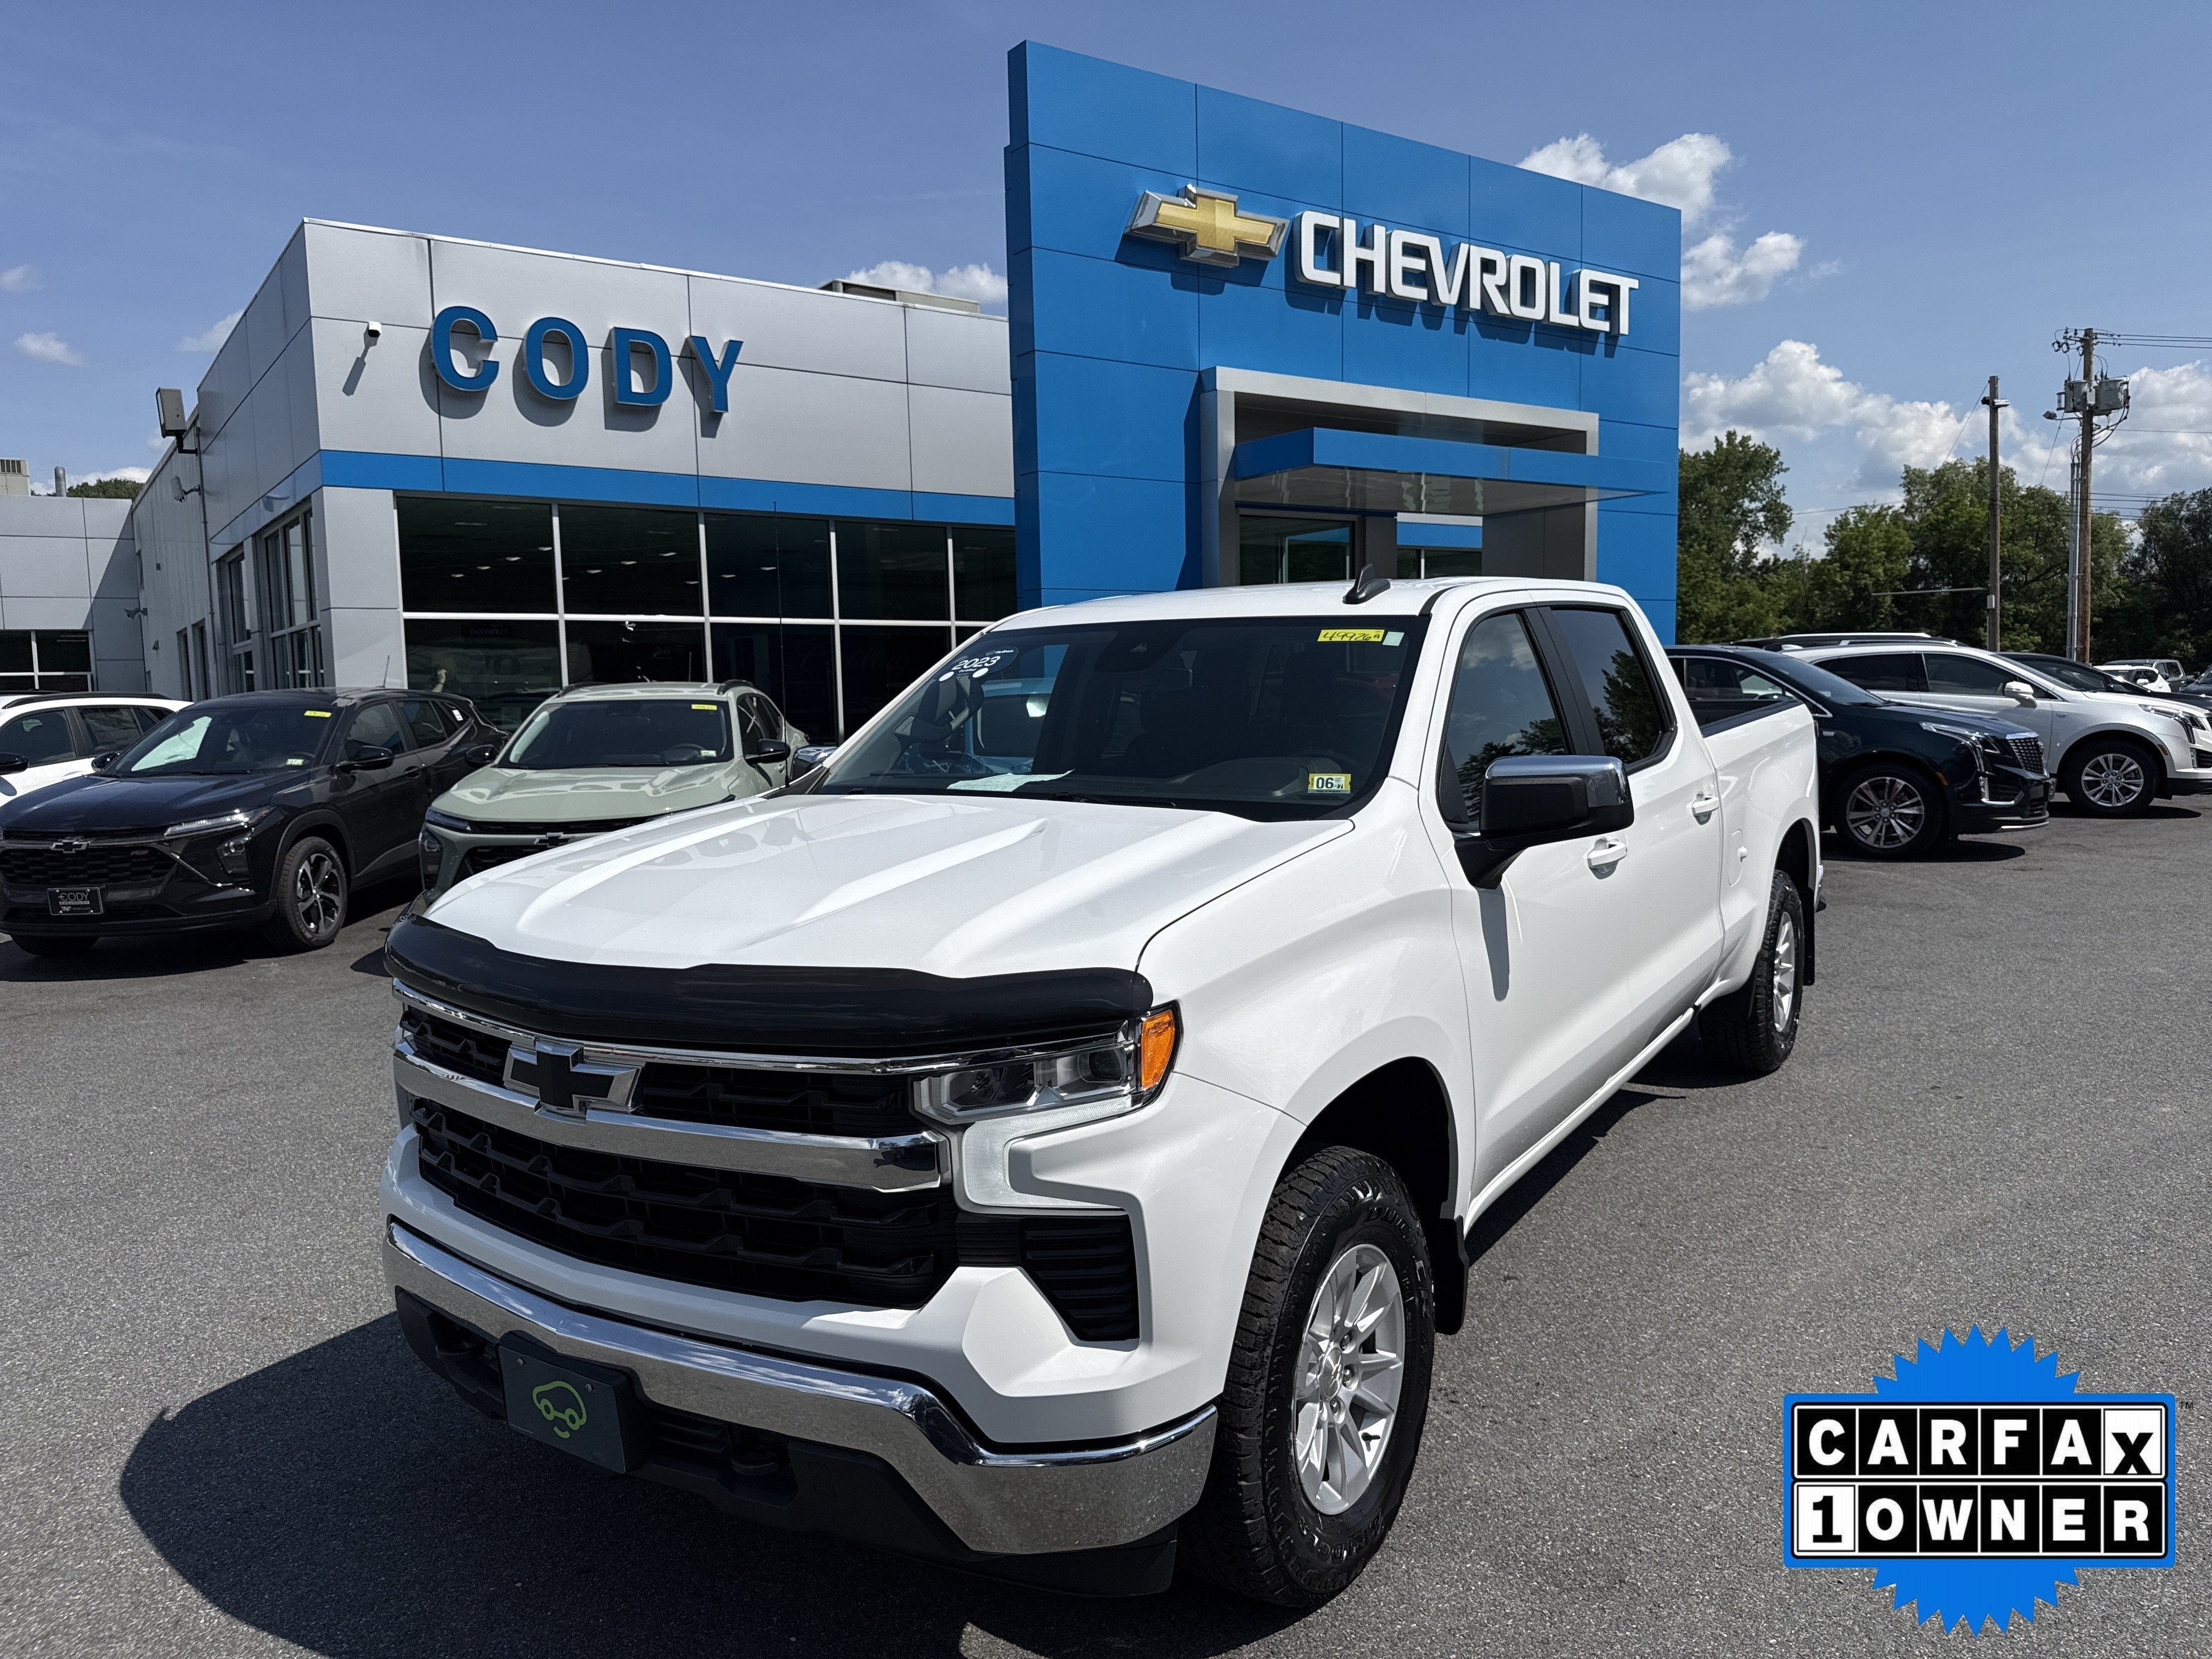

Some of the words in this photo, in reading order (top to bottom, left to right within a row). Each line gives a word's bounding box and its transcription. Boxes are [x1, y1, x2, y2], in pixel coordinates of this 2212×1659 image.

[1293, 210, 1639, 336] CHEVROLET
[431, 305, 744, 414] CODY
[951, 656, 1001, 670] 2023
[1316, 777, 1334, 789] 06
[58, 892, 89, 901] CODY
